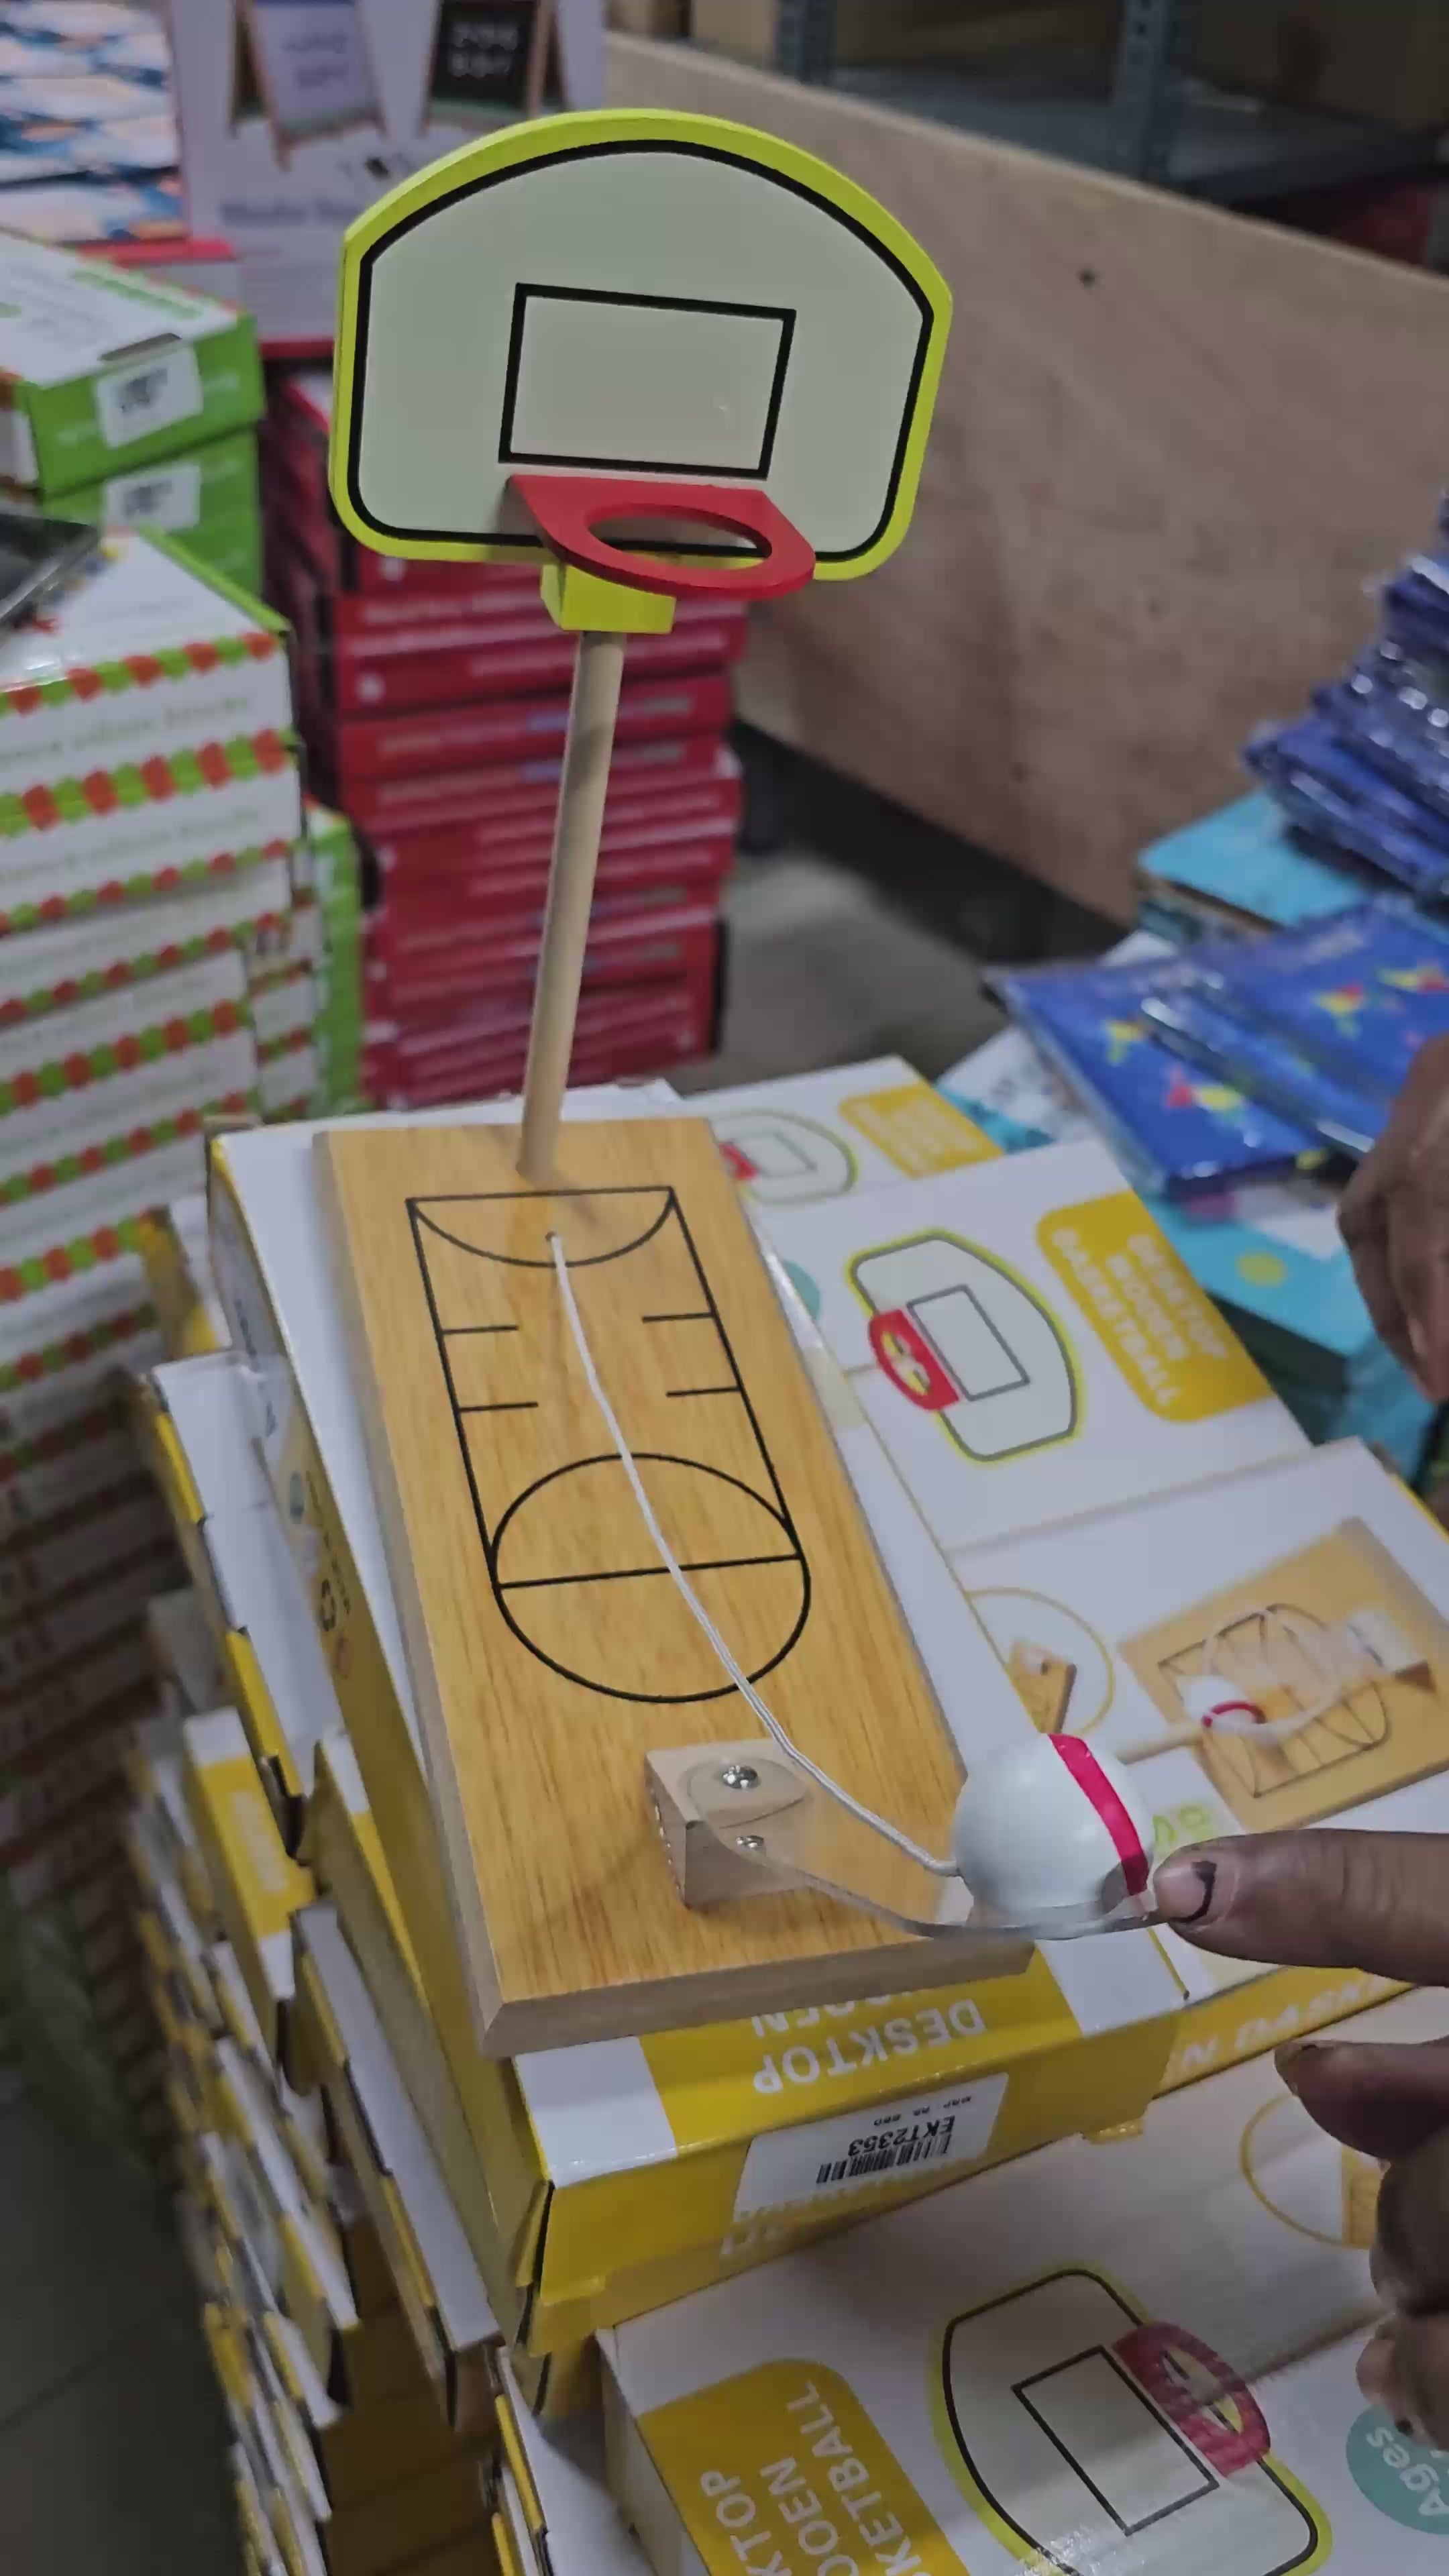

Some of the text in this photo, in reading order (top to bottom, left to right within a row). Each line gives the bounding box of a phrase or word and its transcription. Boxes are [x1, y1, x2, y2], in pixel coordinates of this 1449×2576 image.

[753, 1998, 987, 2094] DESKTOP
[847, 2114, 956, 2157] EKT2353
[785, 2381, 931, 2576] KETBALL
